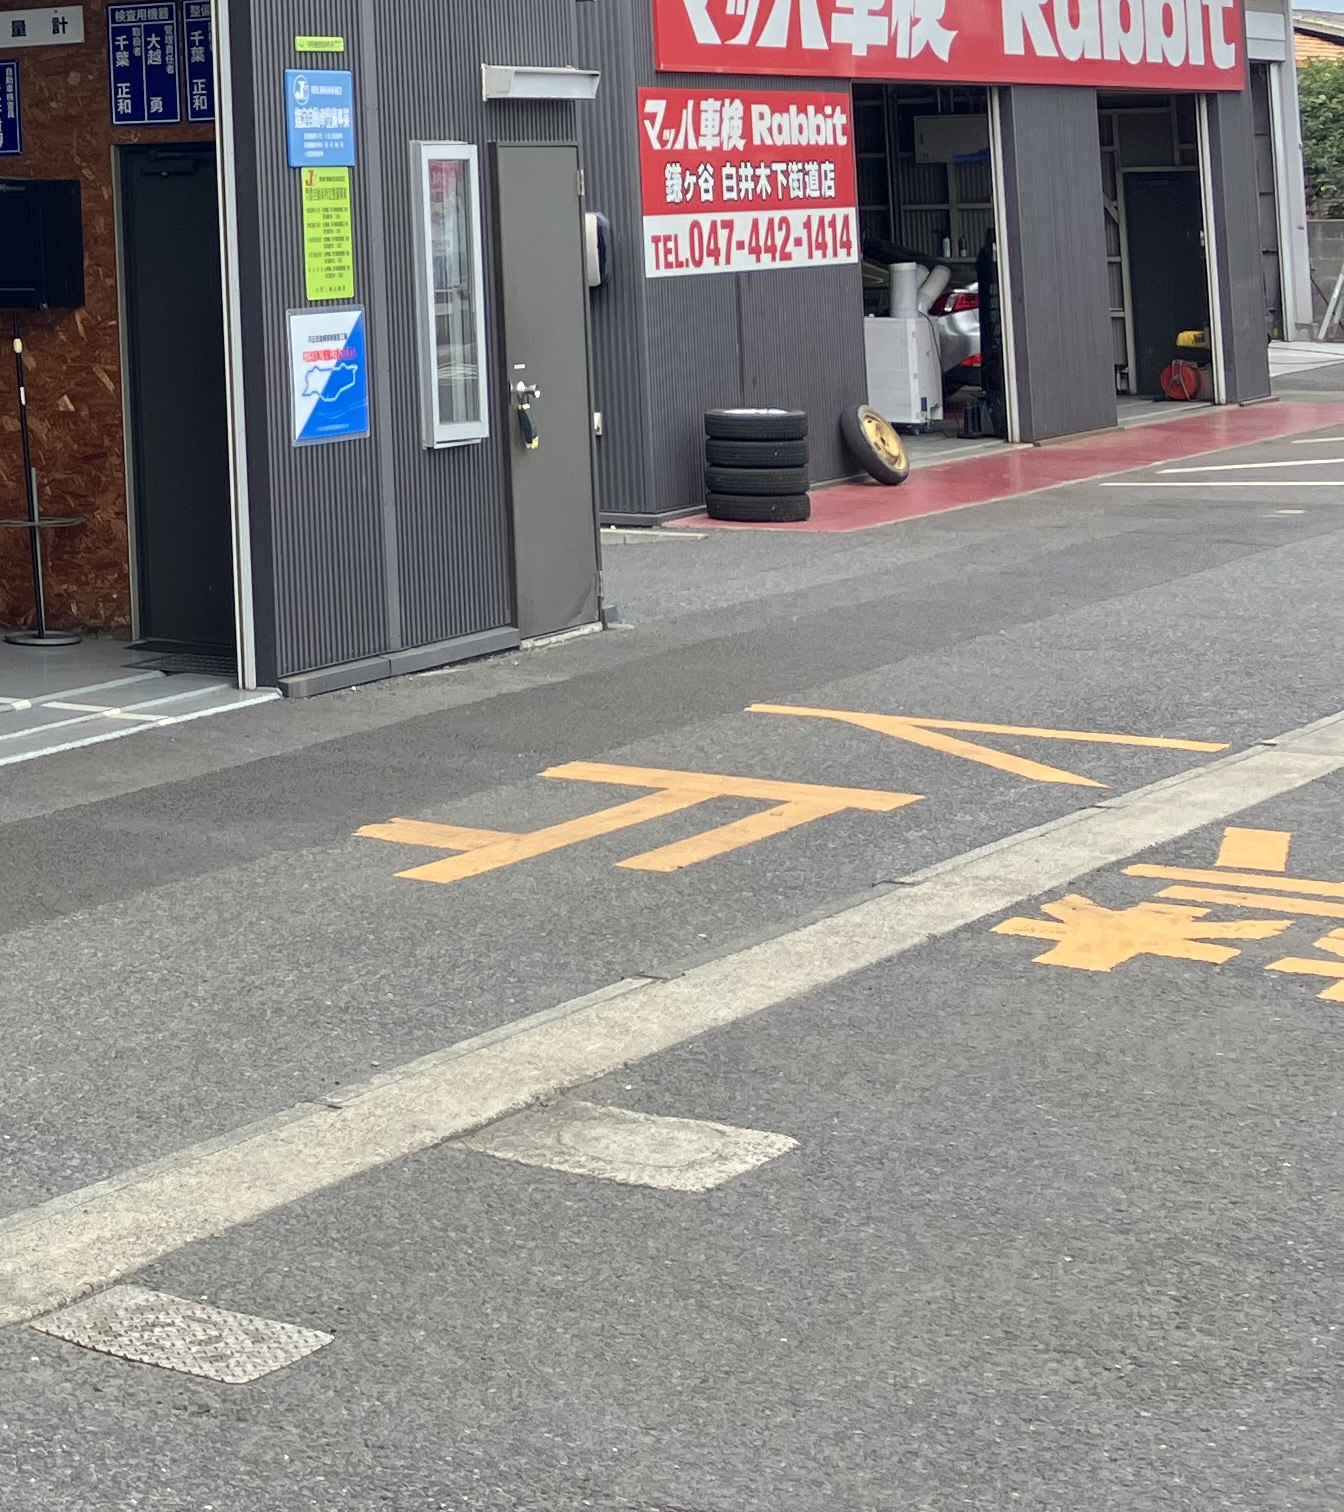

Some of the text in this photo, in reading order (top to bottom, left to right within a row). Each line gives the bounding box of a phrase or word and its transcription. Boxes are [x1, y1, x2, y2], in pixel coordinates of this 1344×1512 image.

[750, 104, 848, 146] Rabbit
[721, 160, 836, 202] 白井木下街道店
